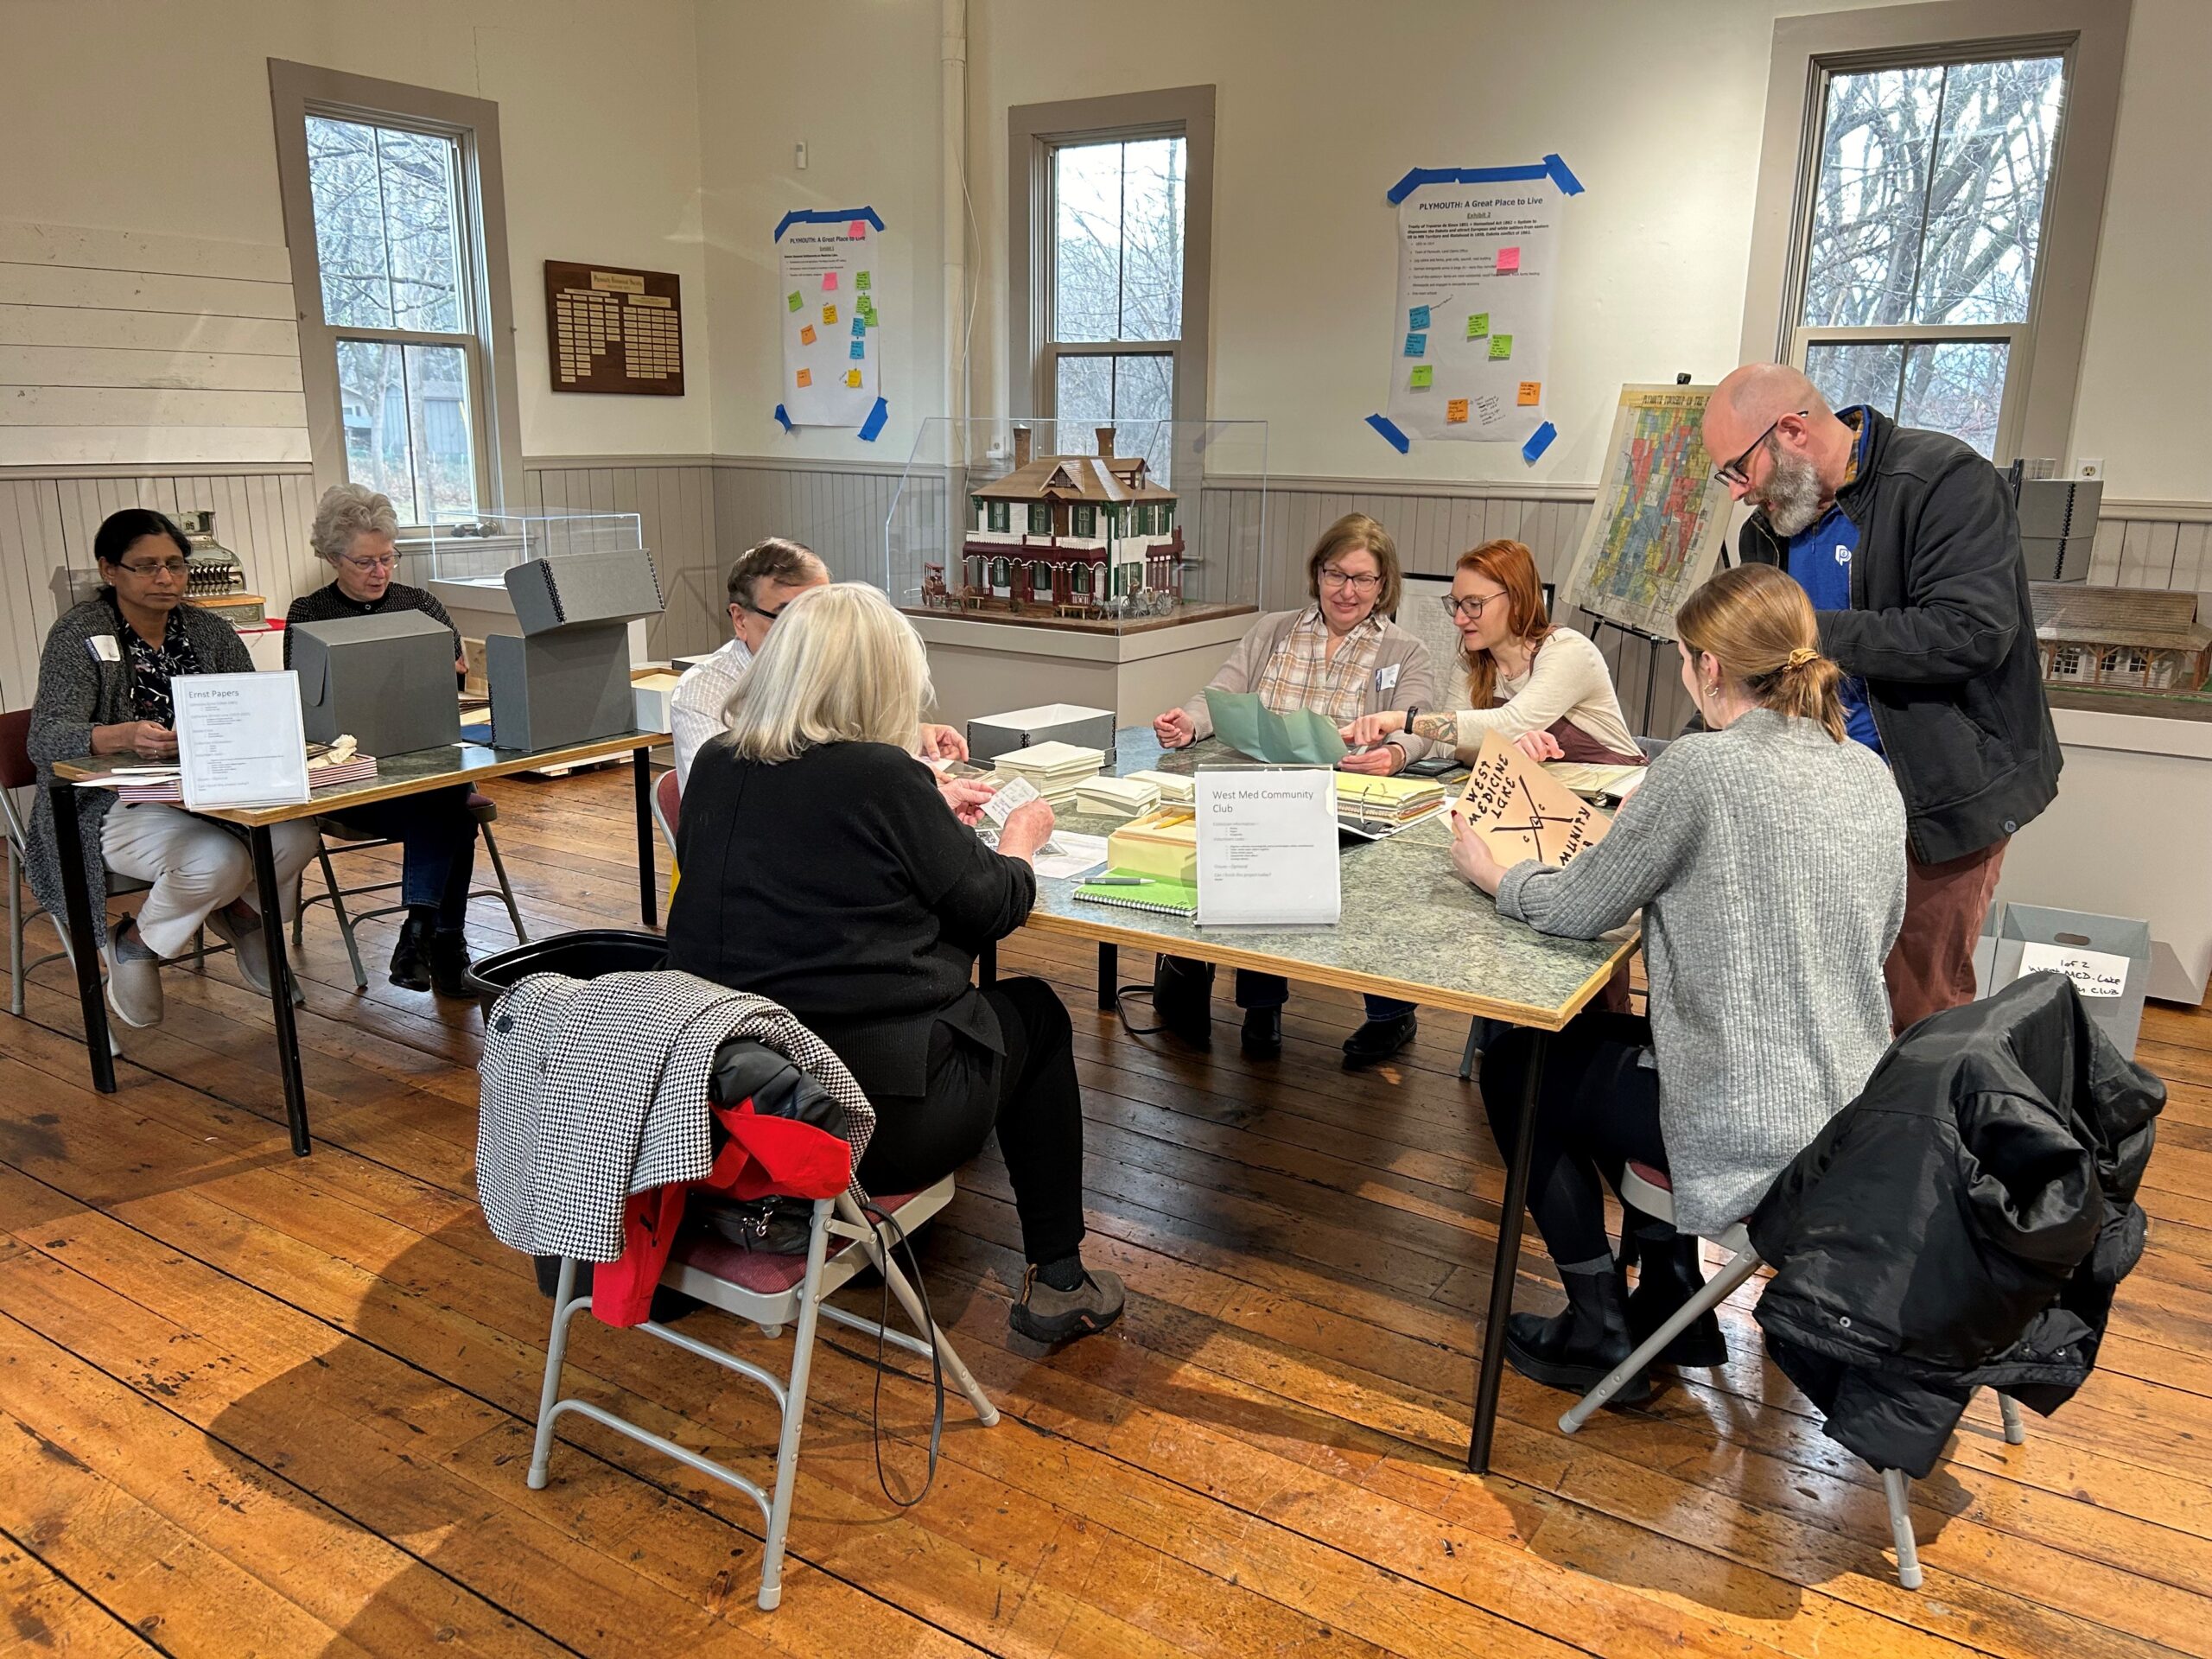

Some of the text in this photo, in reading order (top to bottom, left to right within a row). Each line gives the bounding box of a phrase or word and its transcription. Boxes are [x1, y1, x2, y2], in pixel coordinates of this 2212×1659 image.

[1419, 201, 1462, 210] PLYMOUTH:
[1471, 200, 1493, 208] Great
[212, 690, 239, 699] Papers
[1465, 760, 1491, 804] WEST
[1468, 753, 1508, 826] MEDICINE
[1213, 790, 1314, 800] West Med Community
[1213, 804, 1233, 813] Club
